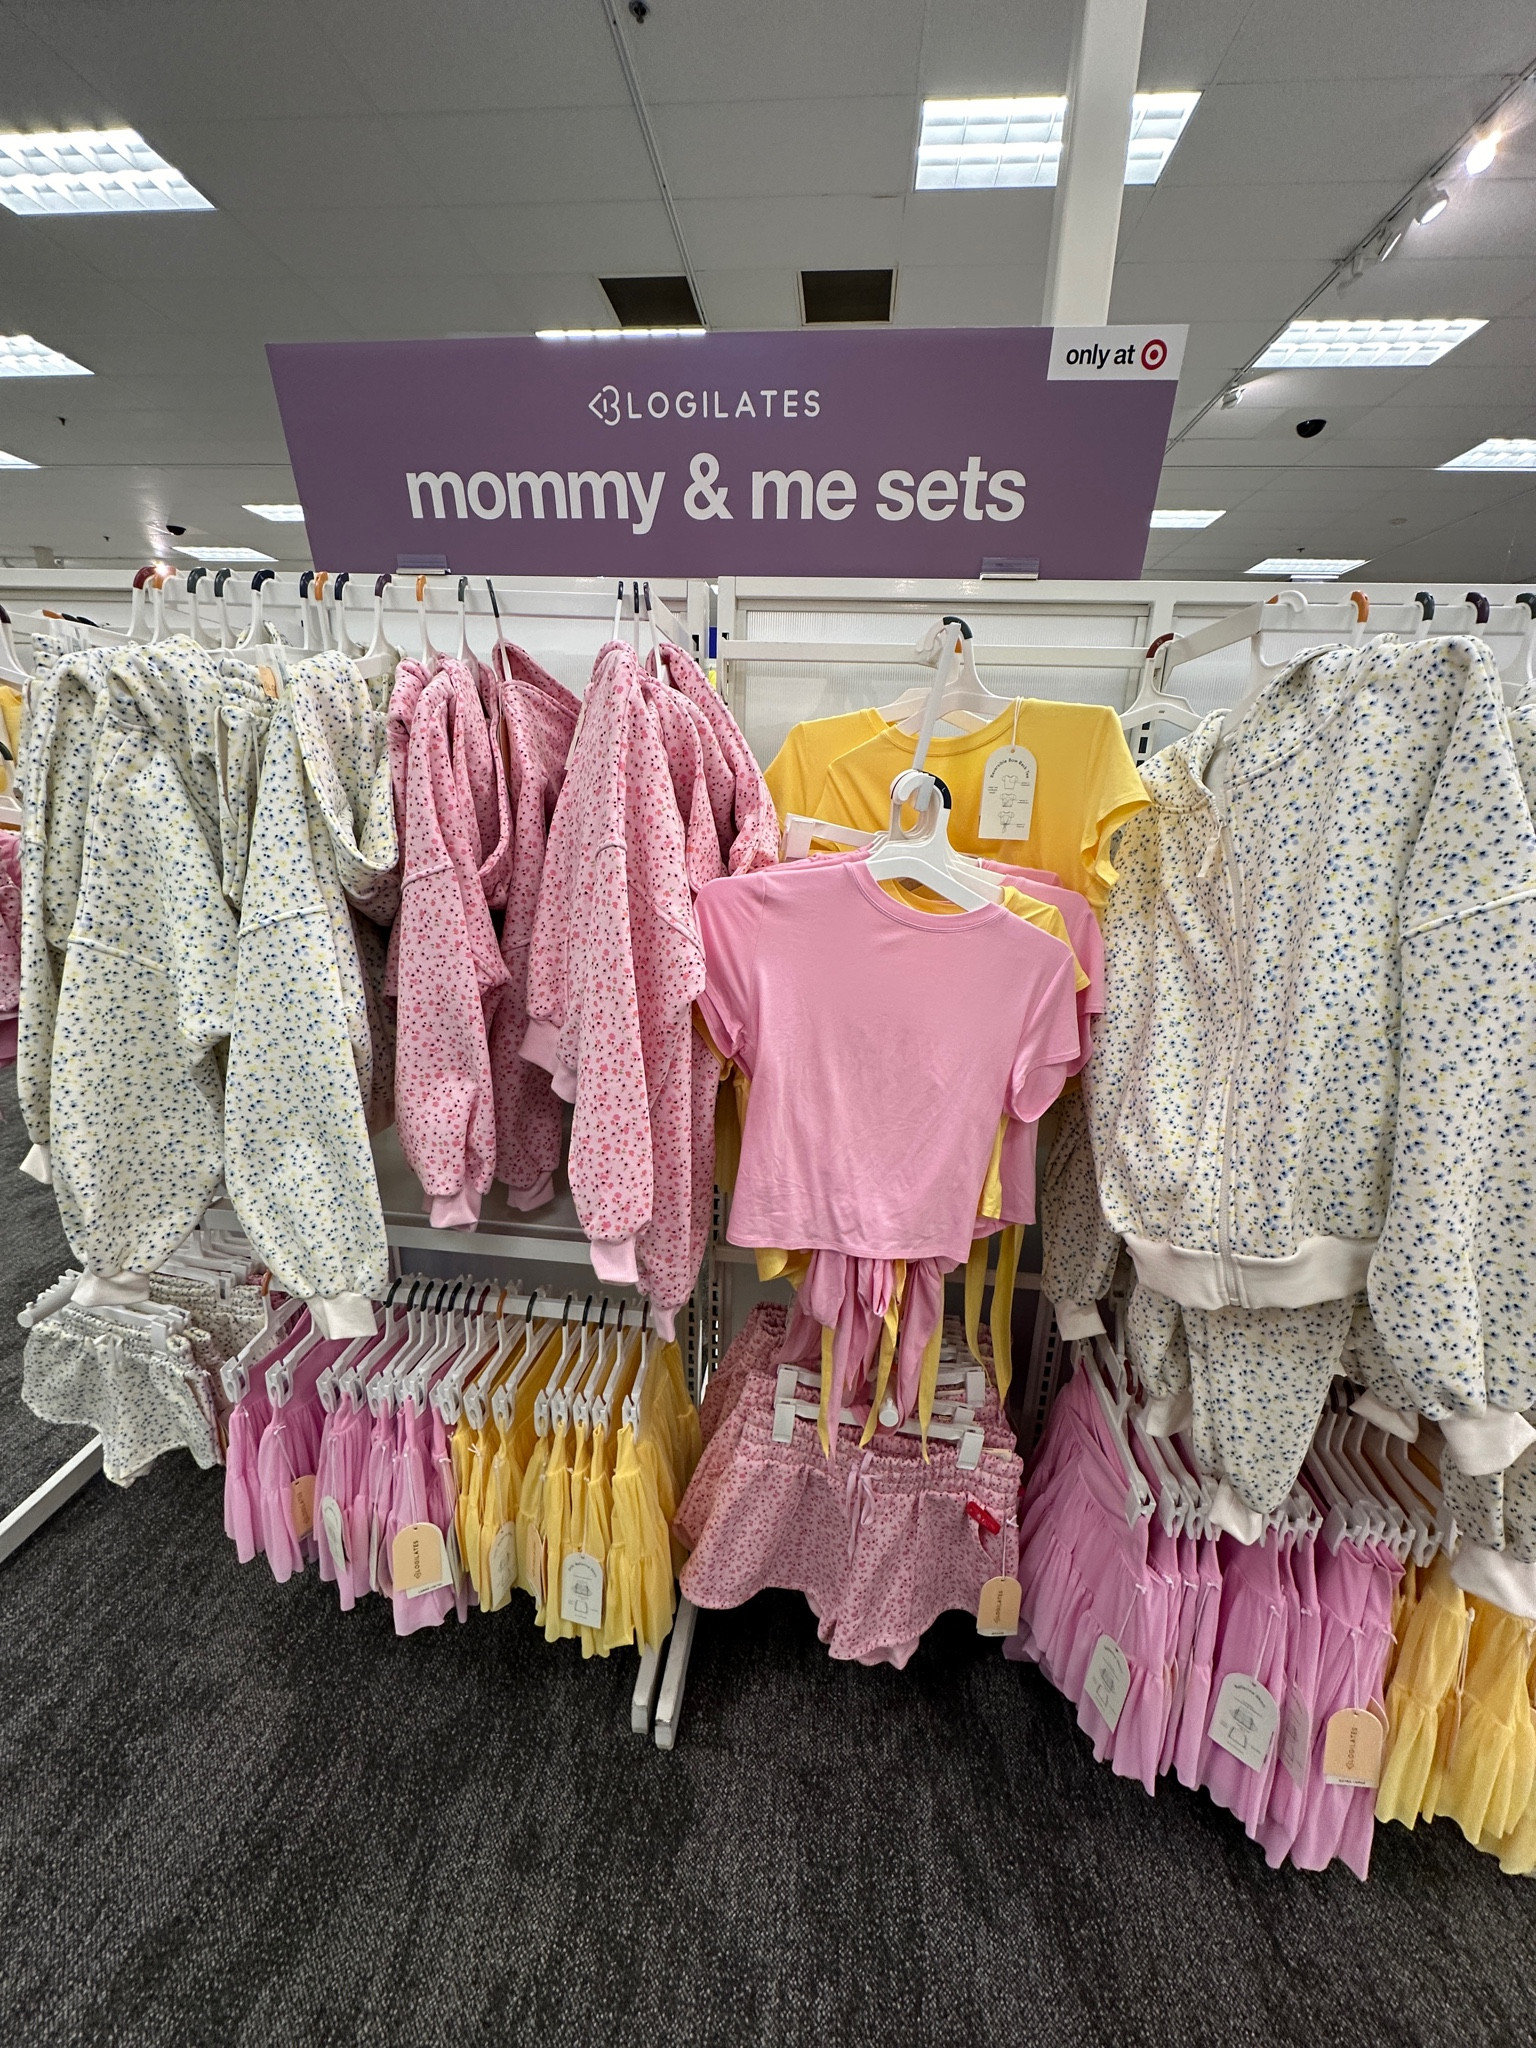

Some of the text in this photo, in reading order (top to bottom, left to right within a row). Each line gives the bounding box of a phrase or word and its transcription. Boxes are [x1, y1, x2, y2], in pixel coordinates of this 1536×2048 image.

[1066, 343, 1136, 370] only at
[588, 384, 821, 426] BLOGILATES
[405, 452, 1027, 535] mommy & me sets
